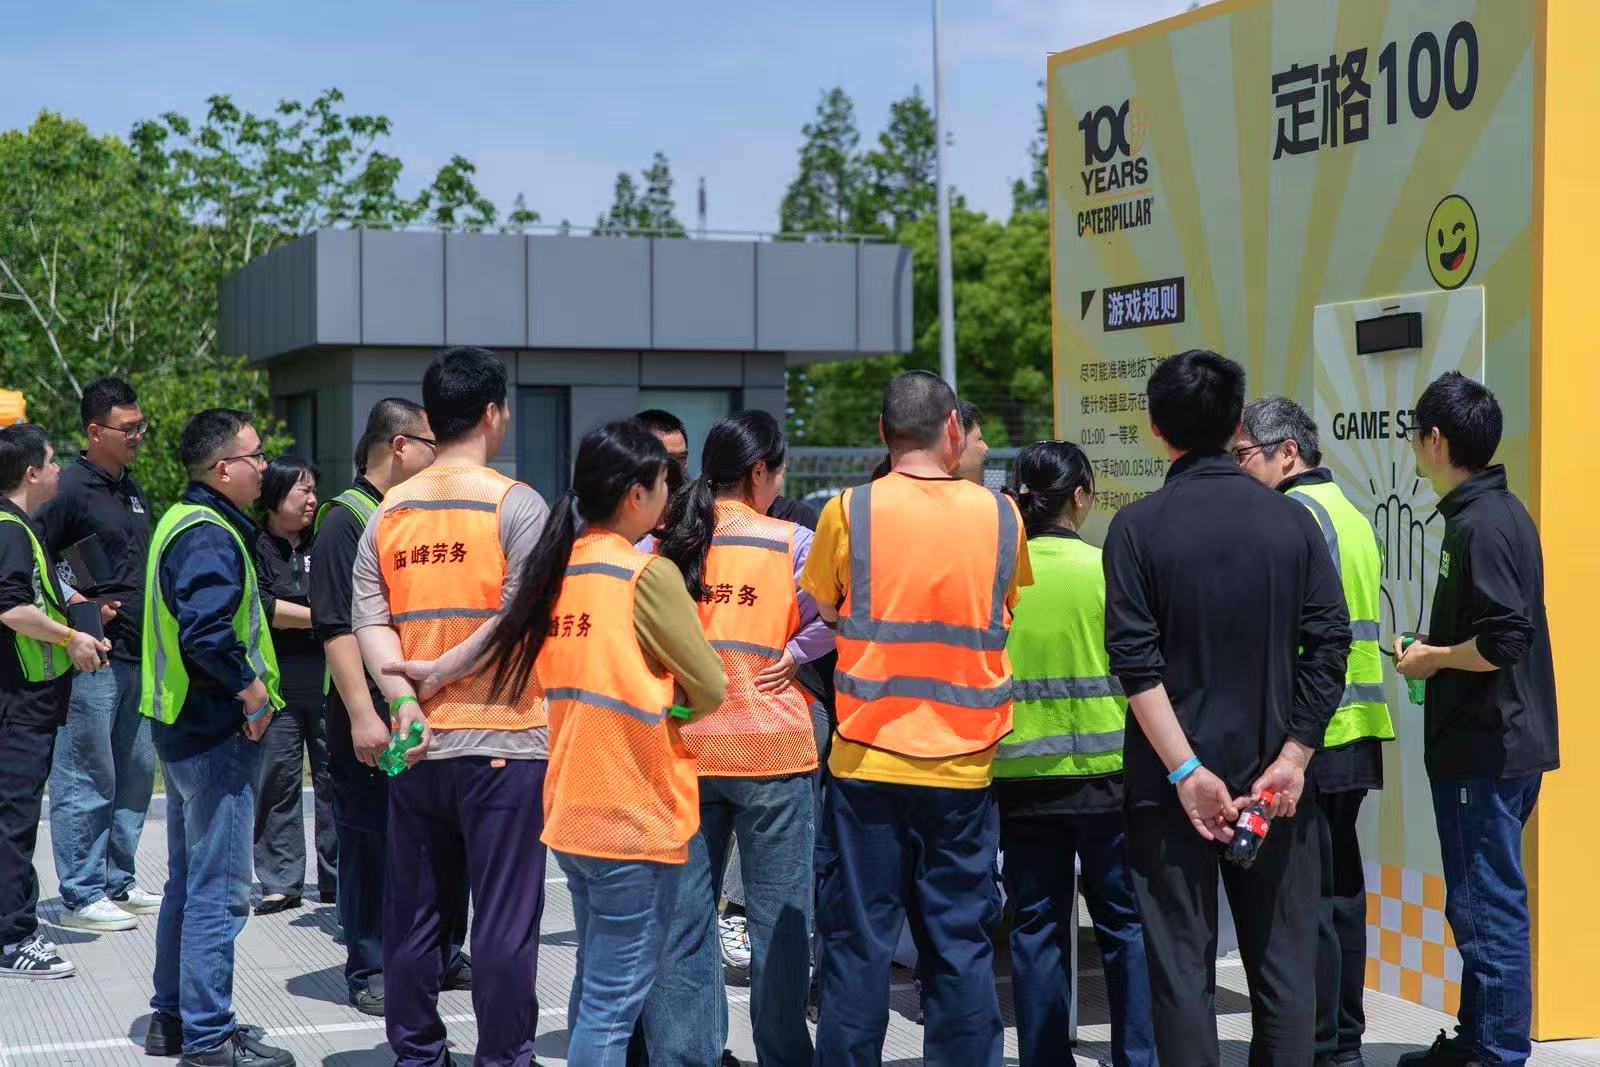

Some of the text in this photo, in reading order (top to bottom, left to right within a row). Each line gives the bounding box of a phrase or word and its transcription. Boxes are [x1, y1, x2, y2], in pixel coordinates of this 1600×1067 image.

[1272, 21, 1479, 160] 定格100
[1081, 157, 1148, 196] YEARS
[1078, 197, 1153, 238] CATERPILLAR
[1108, 284, 1177, 326] 游戏规则
[1081, 356, 1167, 382] 尽可能准确地按下
[1081, 392, 1148, 414] 使计时器显示在
[1081, 424, 1138, 445] 01:00 一等奖
[1333, 411, 1390, 440] GAME
